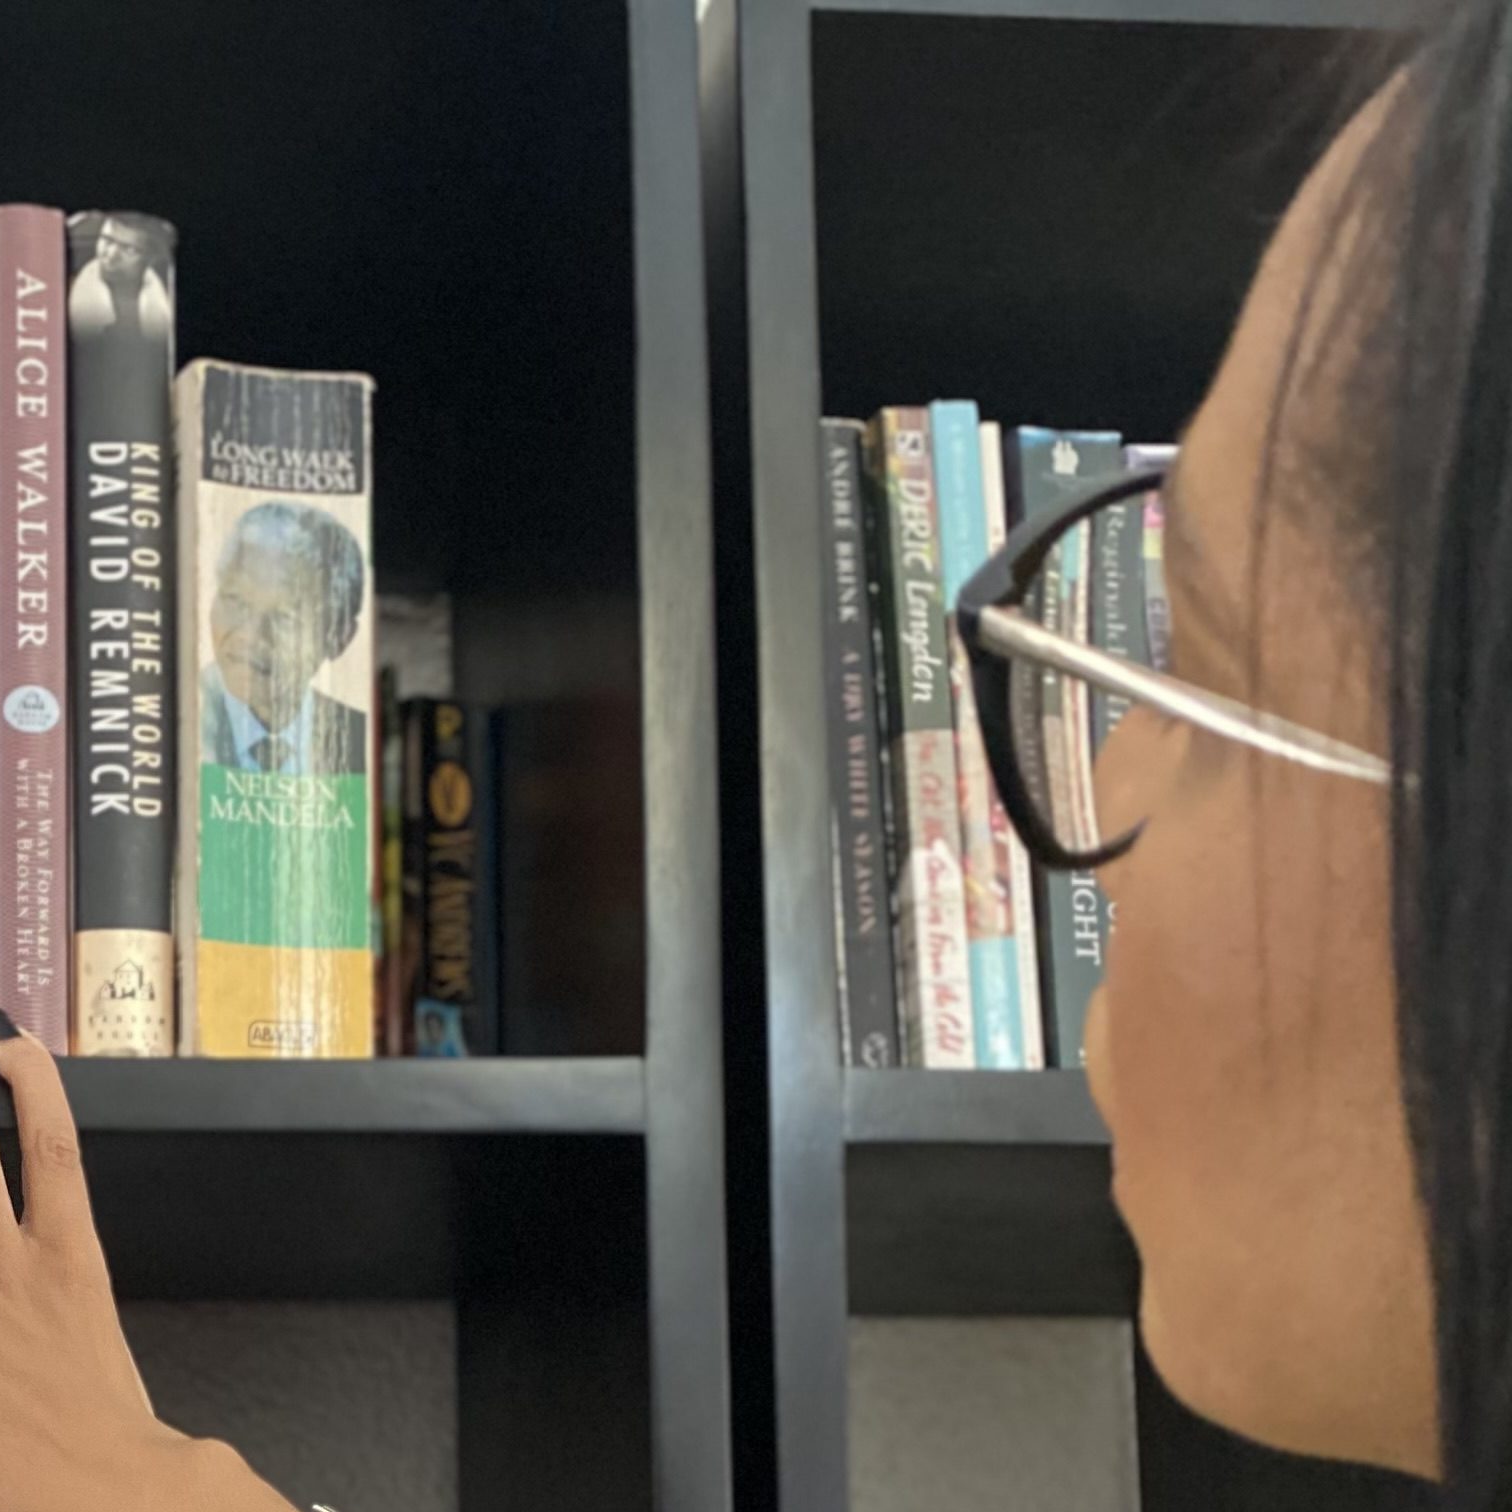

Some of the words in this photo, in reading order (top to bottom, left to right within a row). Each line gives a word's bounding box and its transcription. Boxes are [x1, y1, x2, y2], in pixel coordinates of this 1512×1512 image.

[15, 269, 48, 418] ALICE
[130, 442, 159, 528] KING
[210, 434, 278, 468] LONG
[281, 446, 354, 471] WALK
[231, 468, 356, 492] FREEDOM
[16, 443, 48, 650] WALKER
[89, 441, 128, 583] DAVID
[899, 477, 934, 575] DERIC
[131, 547, 160, 592] OF
[132, 609, 160, 676] THE
[90, 608, 129, 816] REMNICK
[132, 694, 161, 818] WORLD
[834, 541, 860, 624] BRINK
[854, 831, 874, 936] SEASON
[210, 795, 355, 829] MANDELA
[225, 770, 338, 801] NELSON
